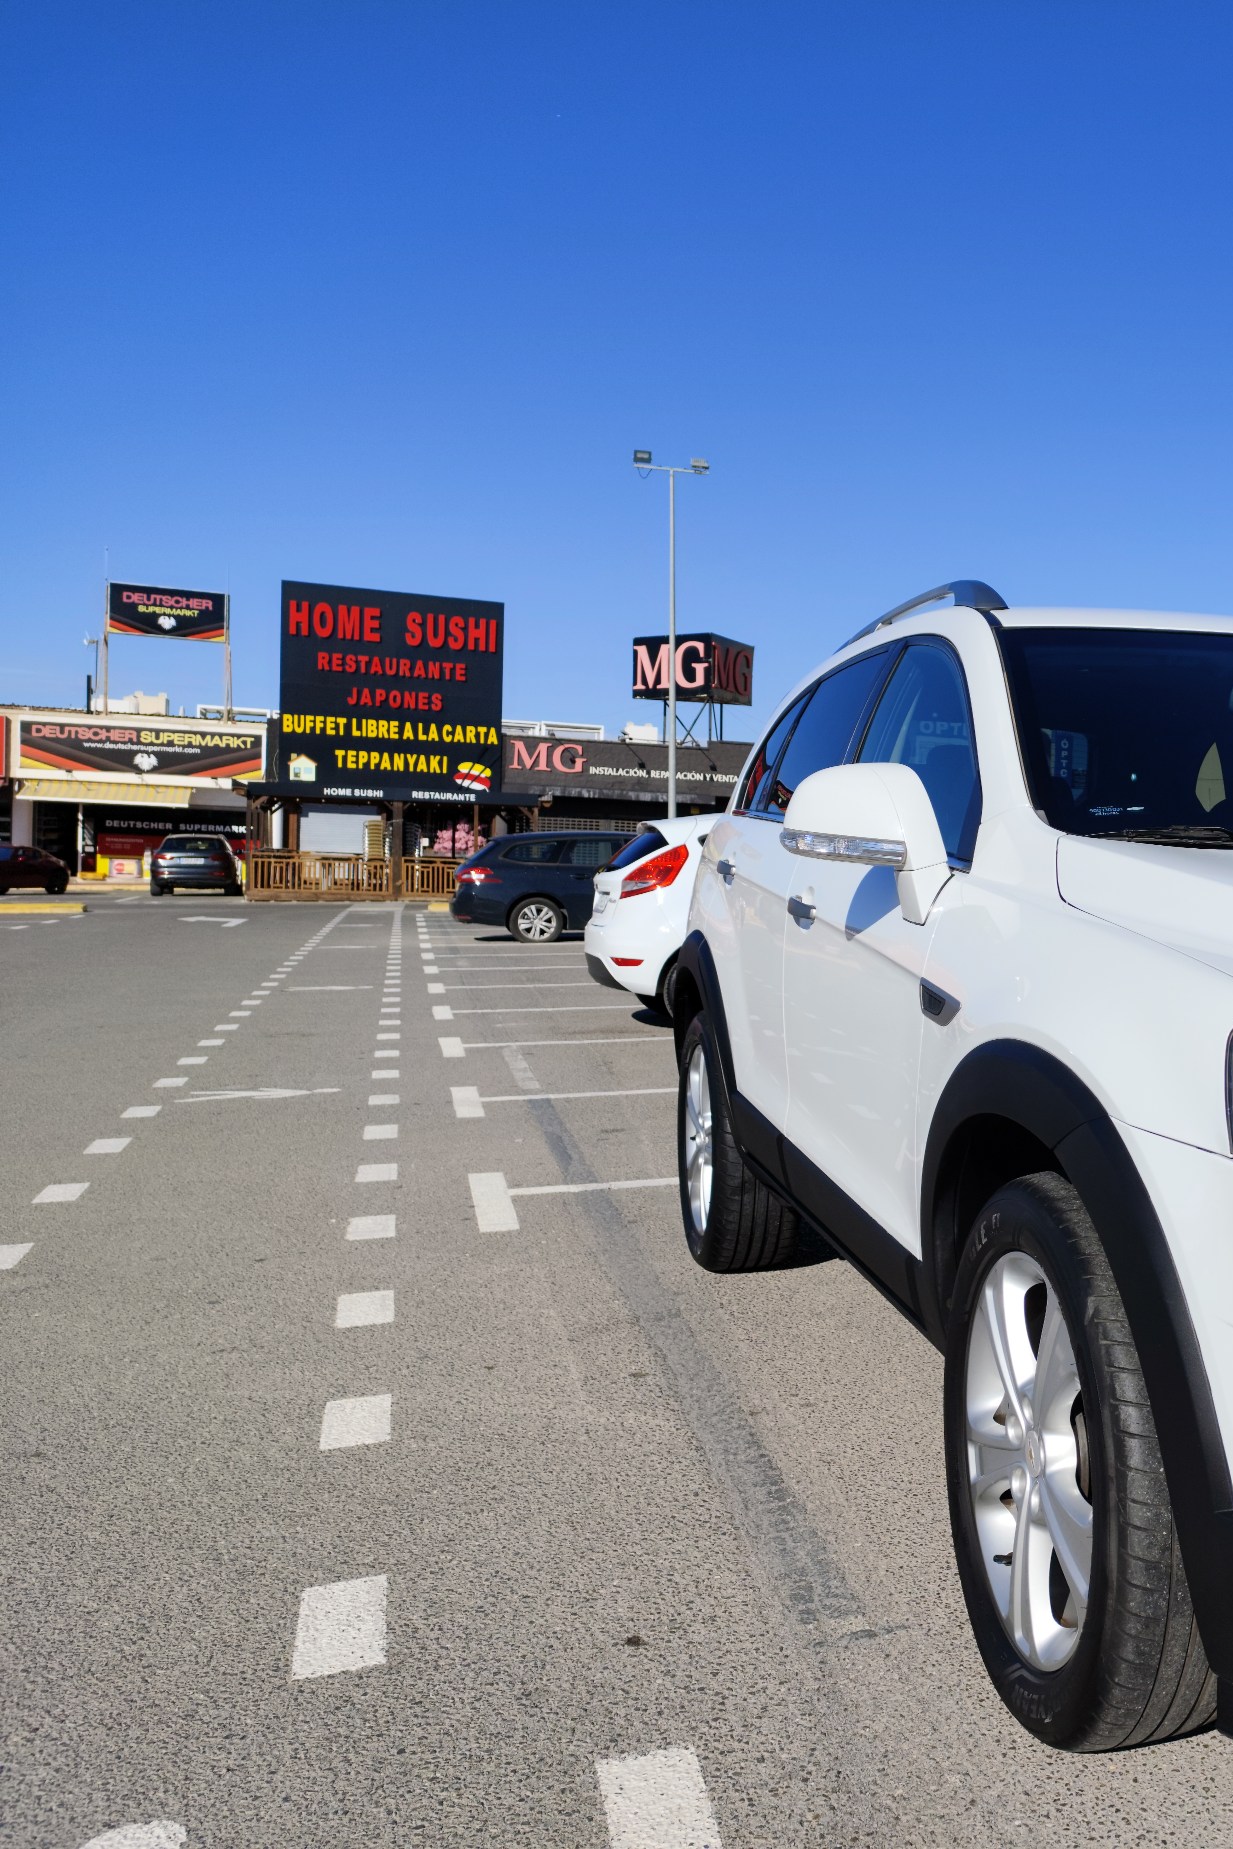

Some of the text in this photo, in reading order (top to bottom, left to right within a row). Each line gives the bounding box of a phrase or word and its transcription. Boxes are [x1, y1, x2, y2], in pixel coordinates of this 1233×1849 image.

[122, 591, 213, 611] DEUTSCHER
[137, 605, 199, 618] SUPERMARKT
[288, 599, 498, 653] HOME SUSHI
[317, 651, 467, 682] RESTAURANTE
[632, 640, 710, 691] MG
[711, 641, 752, 698] MG
[346, 687, 443, 712] JAPONES
[31, 724, 255, 750] DEUTSCHER SUPERMARKT
[282, 713, 499, 745] BUFFET LIBRE A LA CARTA
[83, 741, 201, 754] www.deutschersupermarkt.com
[334, 749, 448, 774] TEPPANYAKI
[508, 740, 587, 774] MG
[589, 765, 649, 779] INSTALACIÓN,
[650, 769, 704, 781] REPAACIÓN
[705, 773, 711, 781] Y
[323, 787, 477, 802] HOME SUSHI RESTAURANTE
[105, 819, 250, 834] DEUTSCHER SUPERMARK
